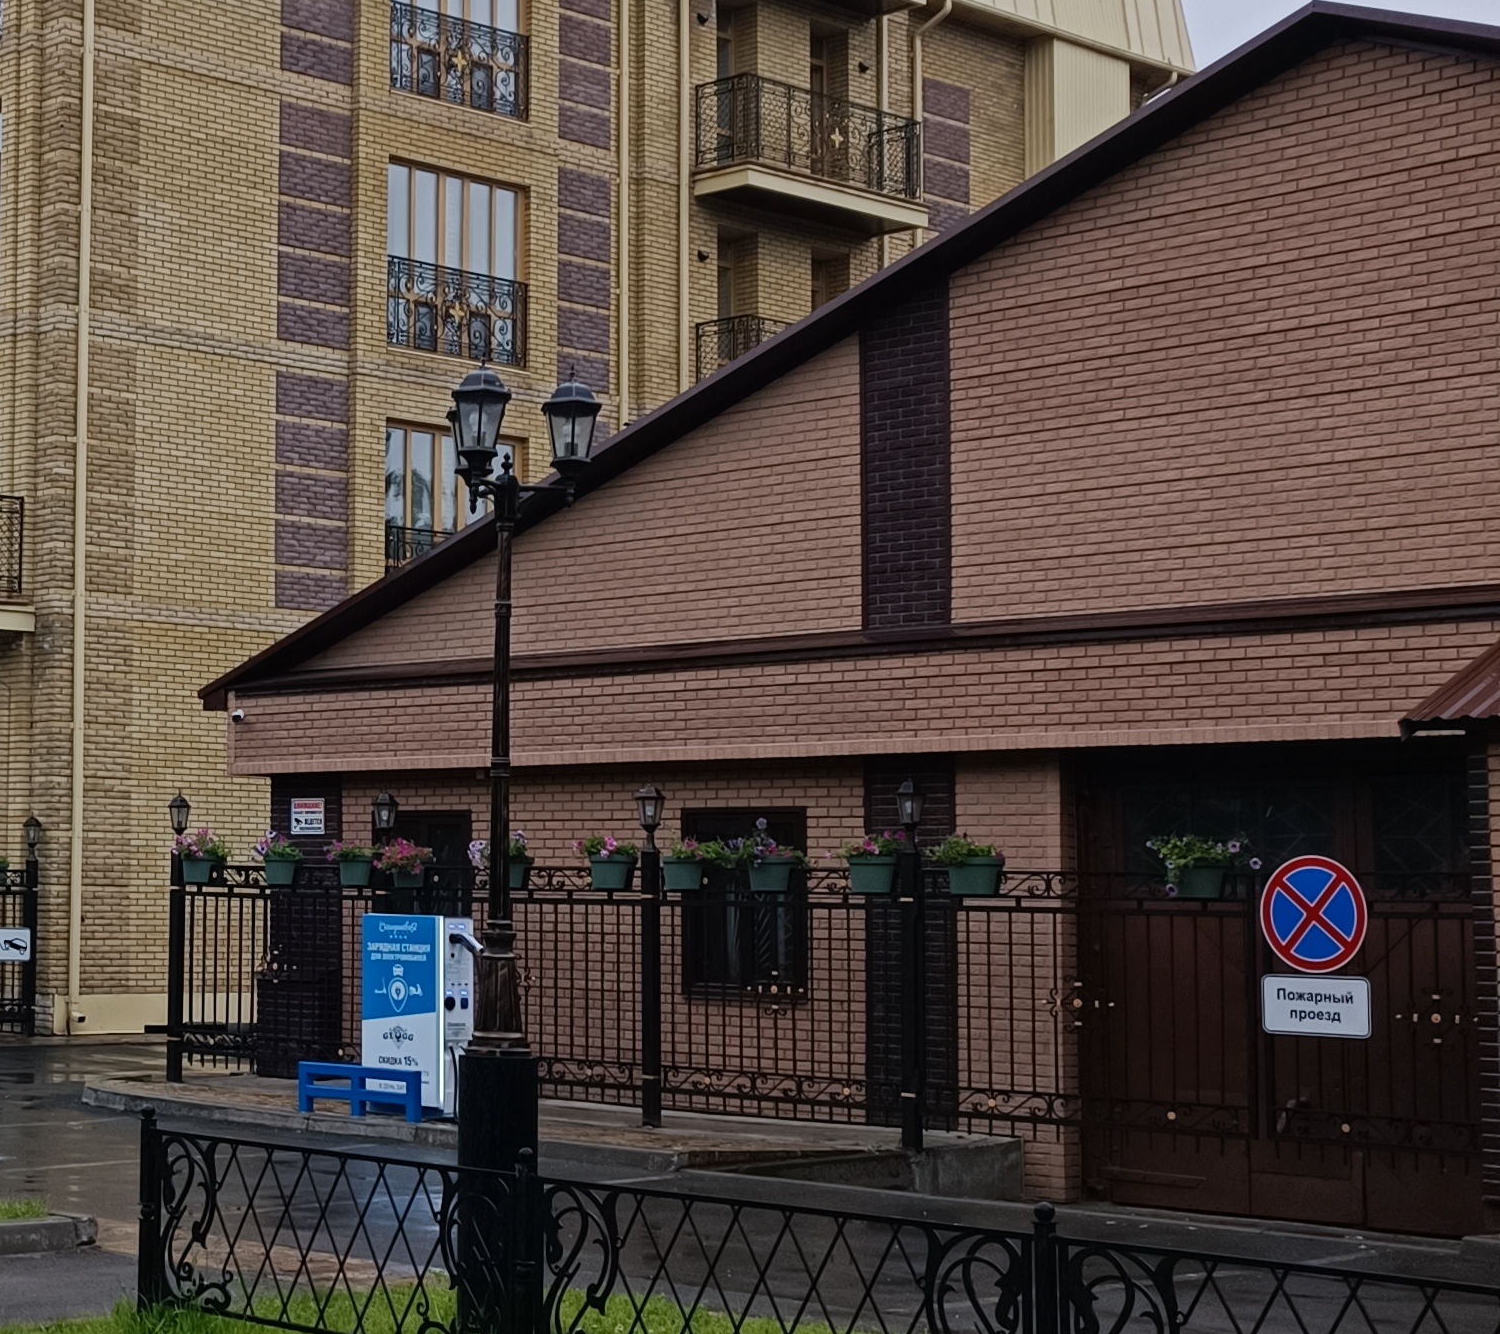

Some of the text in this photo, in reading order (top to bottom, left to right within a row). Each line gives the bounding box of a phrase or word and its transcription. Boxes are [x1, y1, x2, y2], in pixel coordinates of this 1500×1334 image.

[1276, 987, 1354, 1005] Пожарный
[1290, 1009, 1342, 1024] проезд
[378, 1055, 419, 1067] СКИДКА 15%
